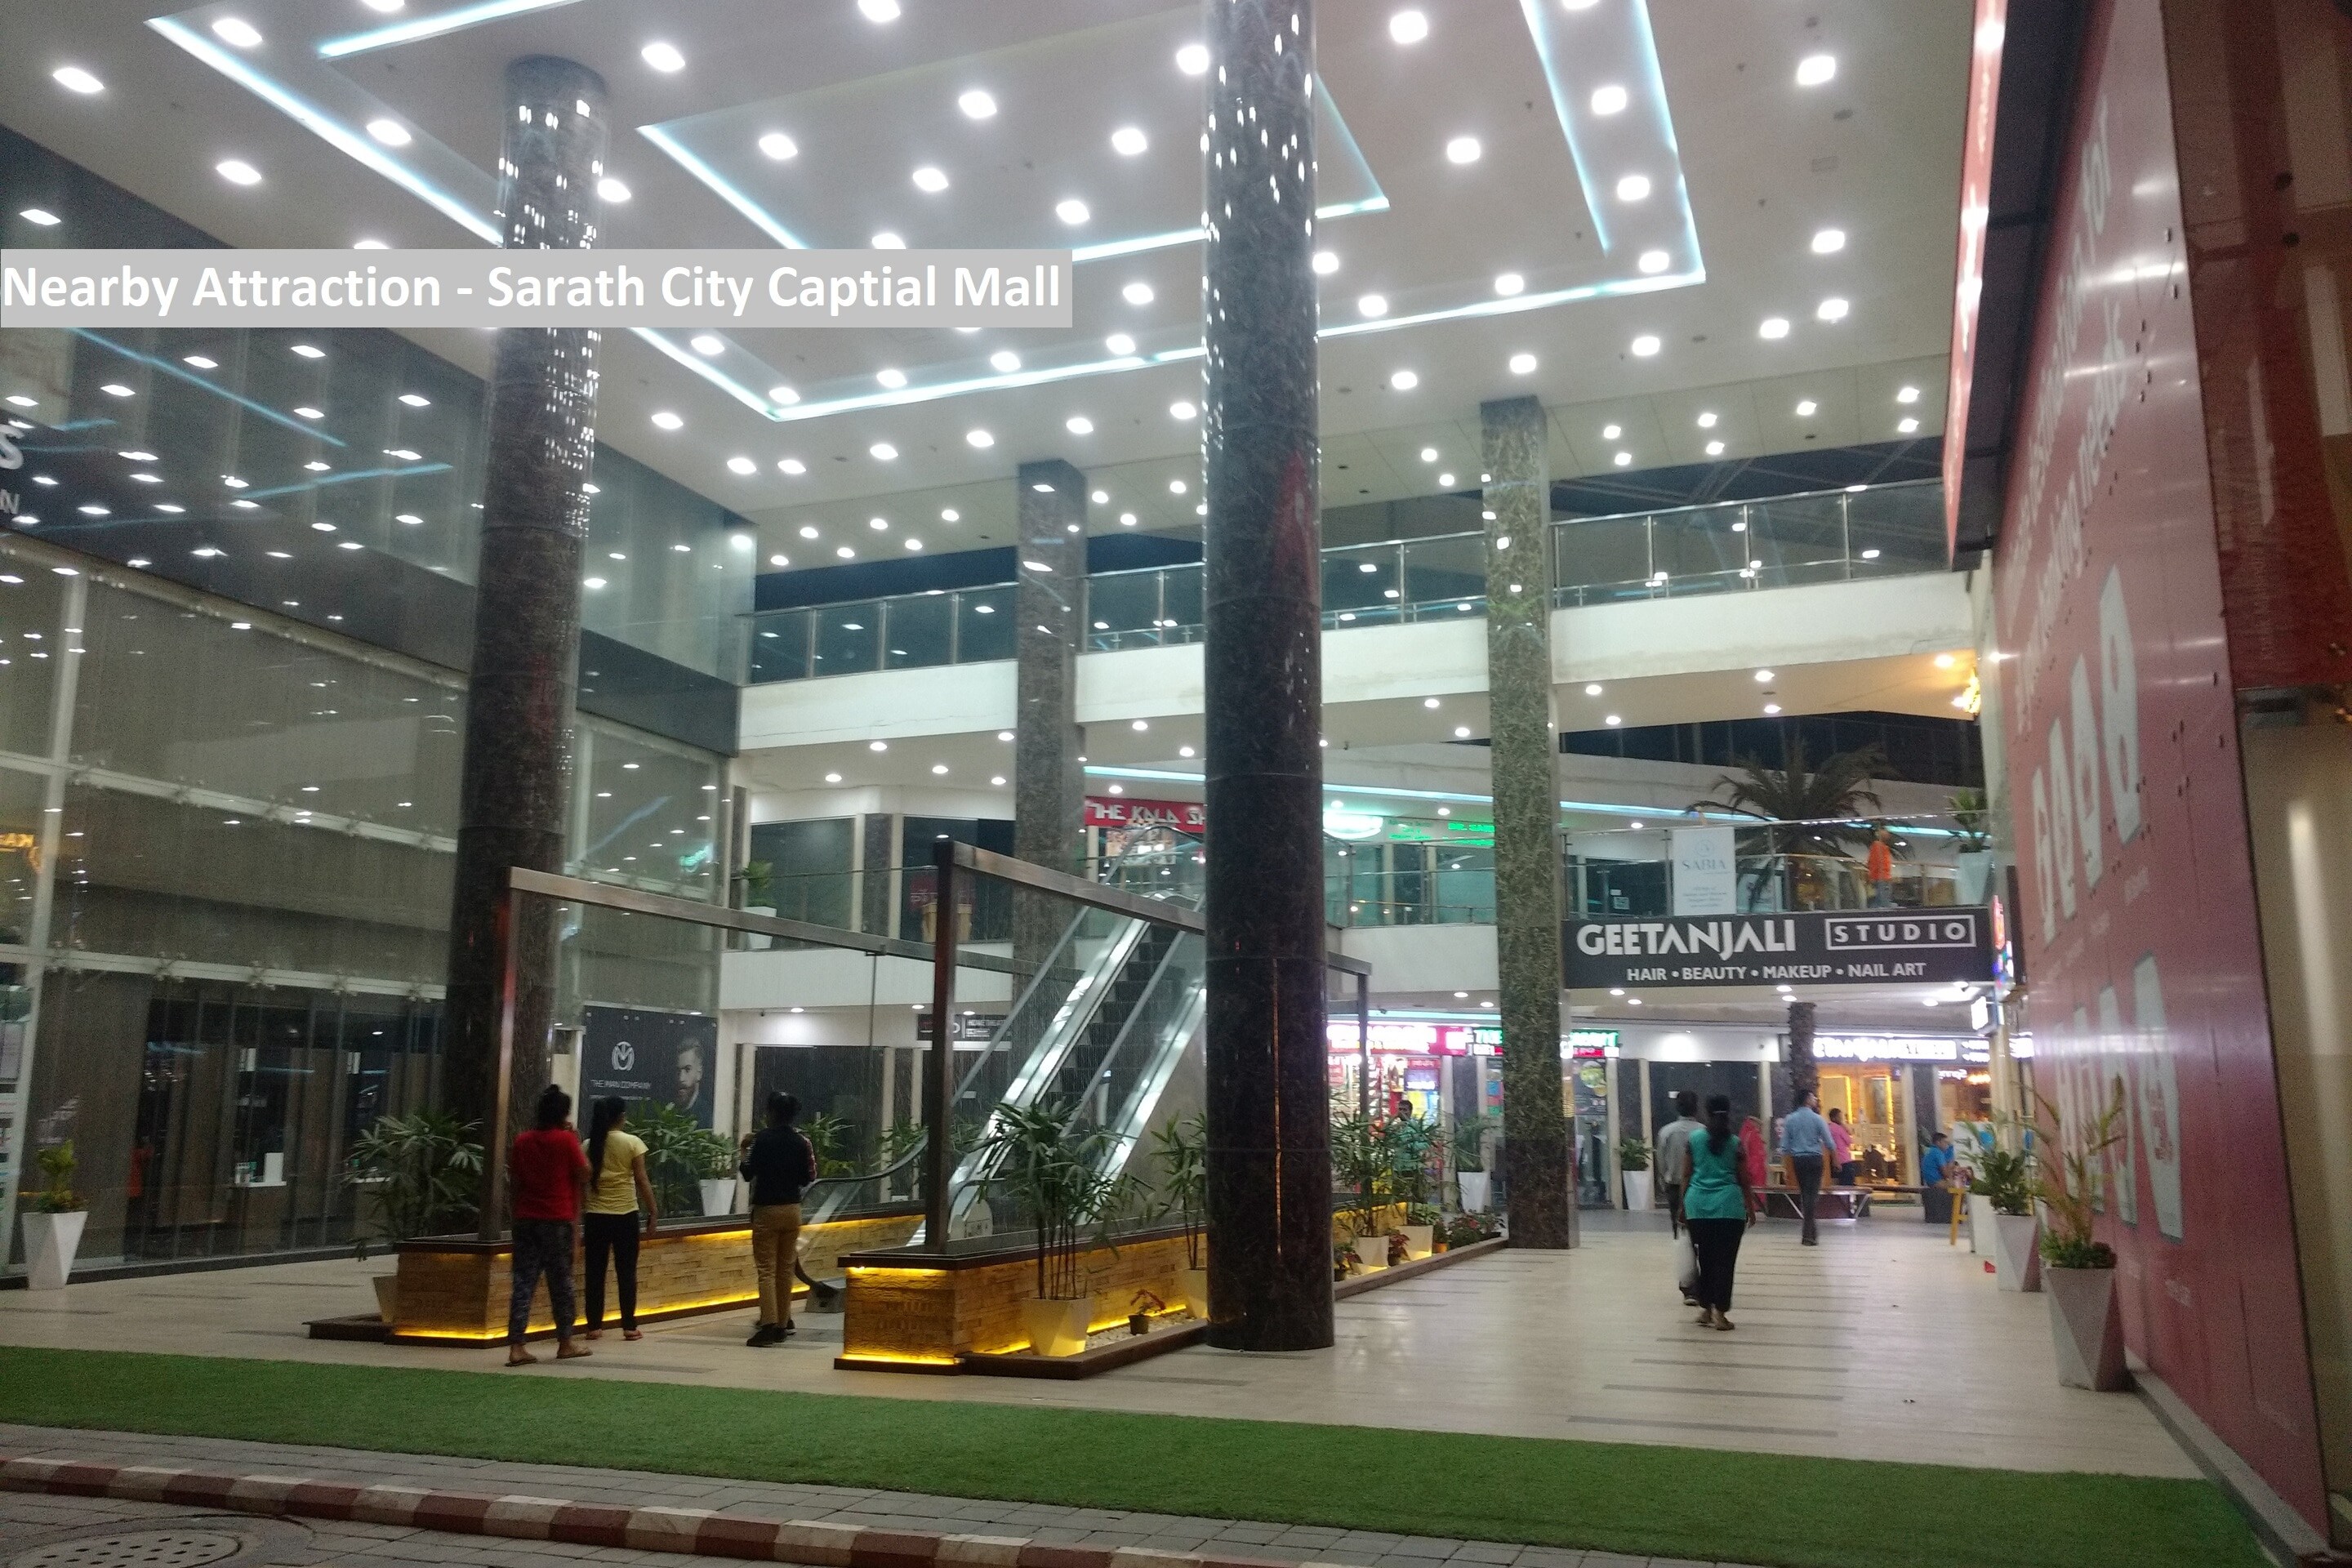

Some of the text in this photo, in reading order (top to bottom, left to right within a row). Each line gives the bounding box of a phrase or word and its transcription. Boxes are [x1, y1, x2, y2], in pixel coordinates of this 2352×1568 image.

[1086, 802, 1126, 821] THE
[1130, 805, 1182, 824] KALA
[1682, 858, 1726, 871] SABIA
[1576, 919, 1797, 961] GEETANJALI
[1834, 922, 1967, 943] STUDIO
[1626, 962, 1927, 982] HAIR BEAUTY MAKEUP NAIL ART
